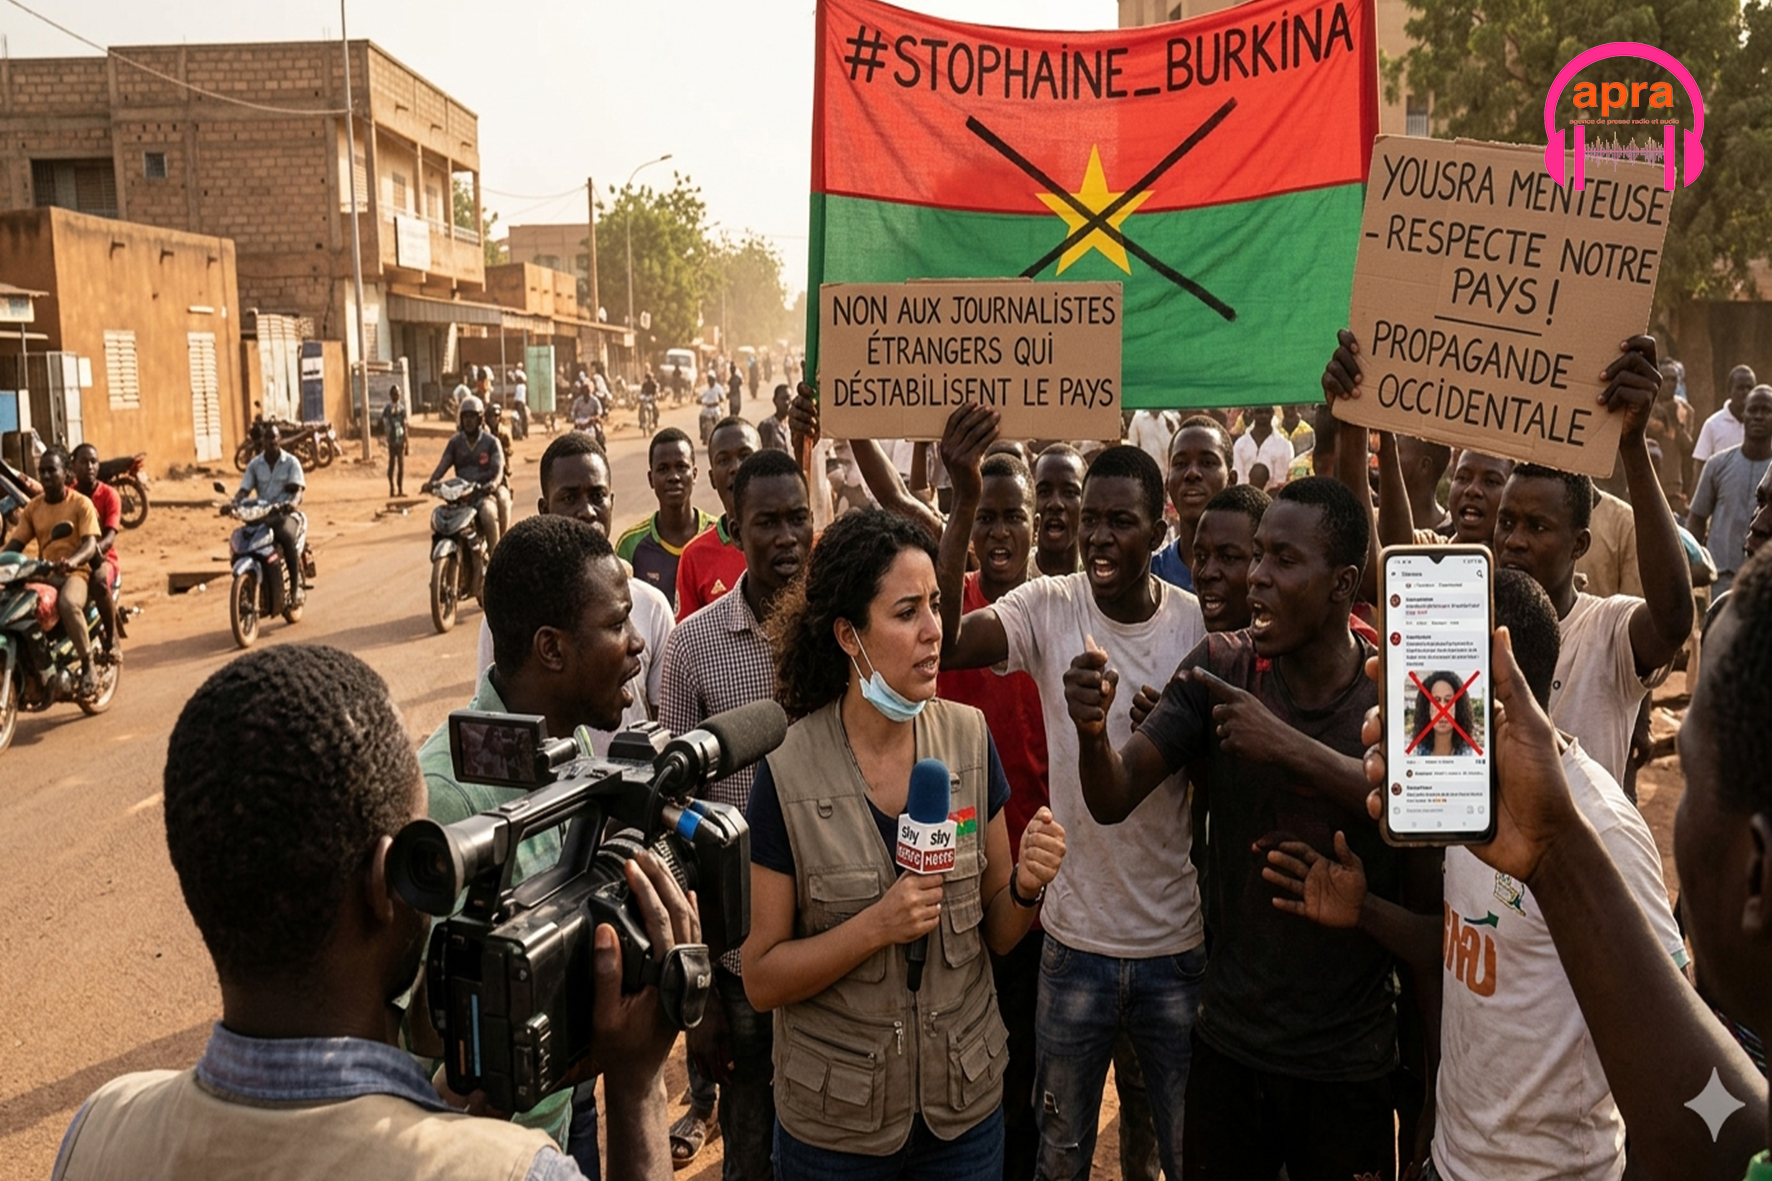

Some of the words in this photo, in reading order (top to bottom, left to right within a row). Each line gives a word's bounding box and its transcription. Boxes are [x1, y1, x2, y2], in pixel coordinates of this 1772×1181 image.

[1382, 154, 1494, 205] YOUSRA
[1508, 170, 1670, 226] MENTEUSE
[1560, 238, 1658, 285] NOTRE
[833, 296, 887, 326] NON
[897, 297, 942, 325] AUX
[867, 328, 1002, 365] ÉTRANGERS
[1371, 320, 1574, 390] PROPAGANDE
[1023, 378, 1050, 406] LE
[1059, 377, 1114, 409] PAYS
